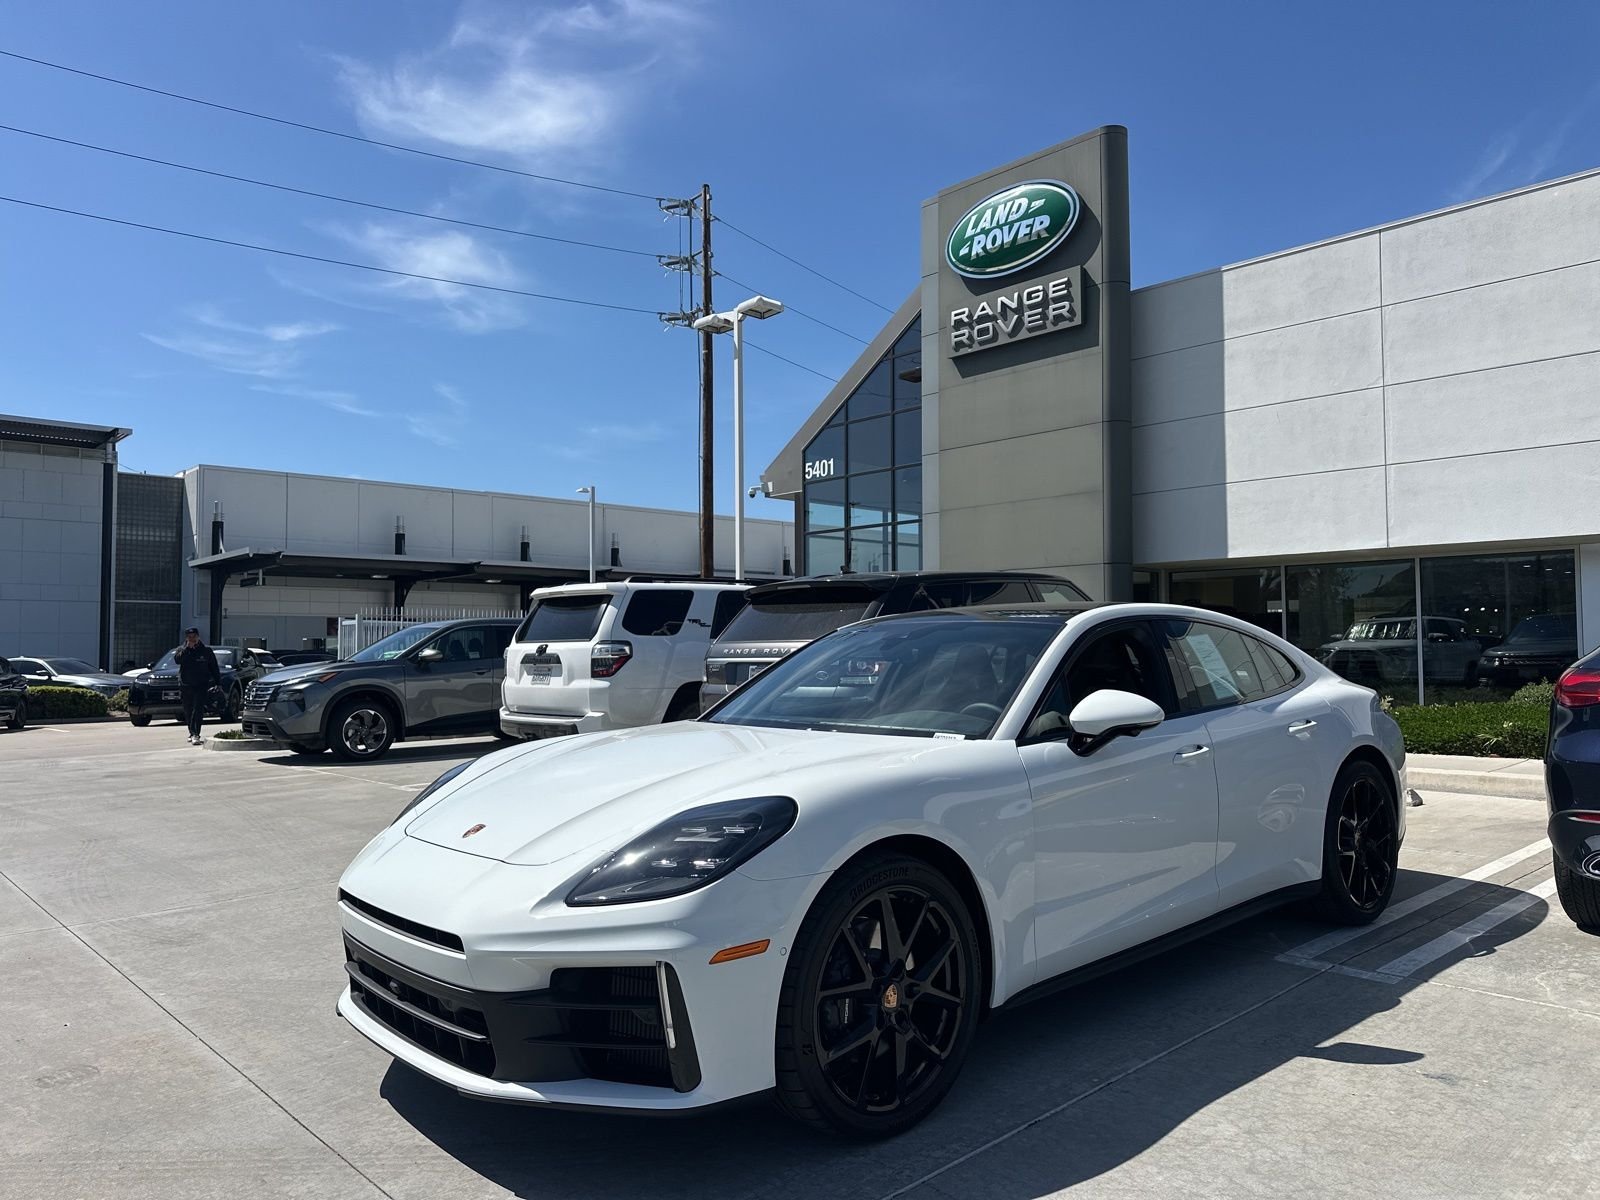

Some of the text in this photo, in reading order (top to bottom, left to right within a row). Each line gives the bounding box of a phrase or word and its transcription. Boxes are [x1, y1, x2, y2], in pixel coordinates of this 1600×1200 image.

[964, 197, 1029, 238] LAND
[970, 214, 1051, 260] ROVER
[951, 277, 1069, 327] RANGE
[951, 301, 1073, 349] ROVER
[805, 458, 834, 479] 5401
